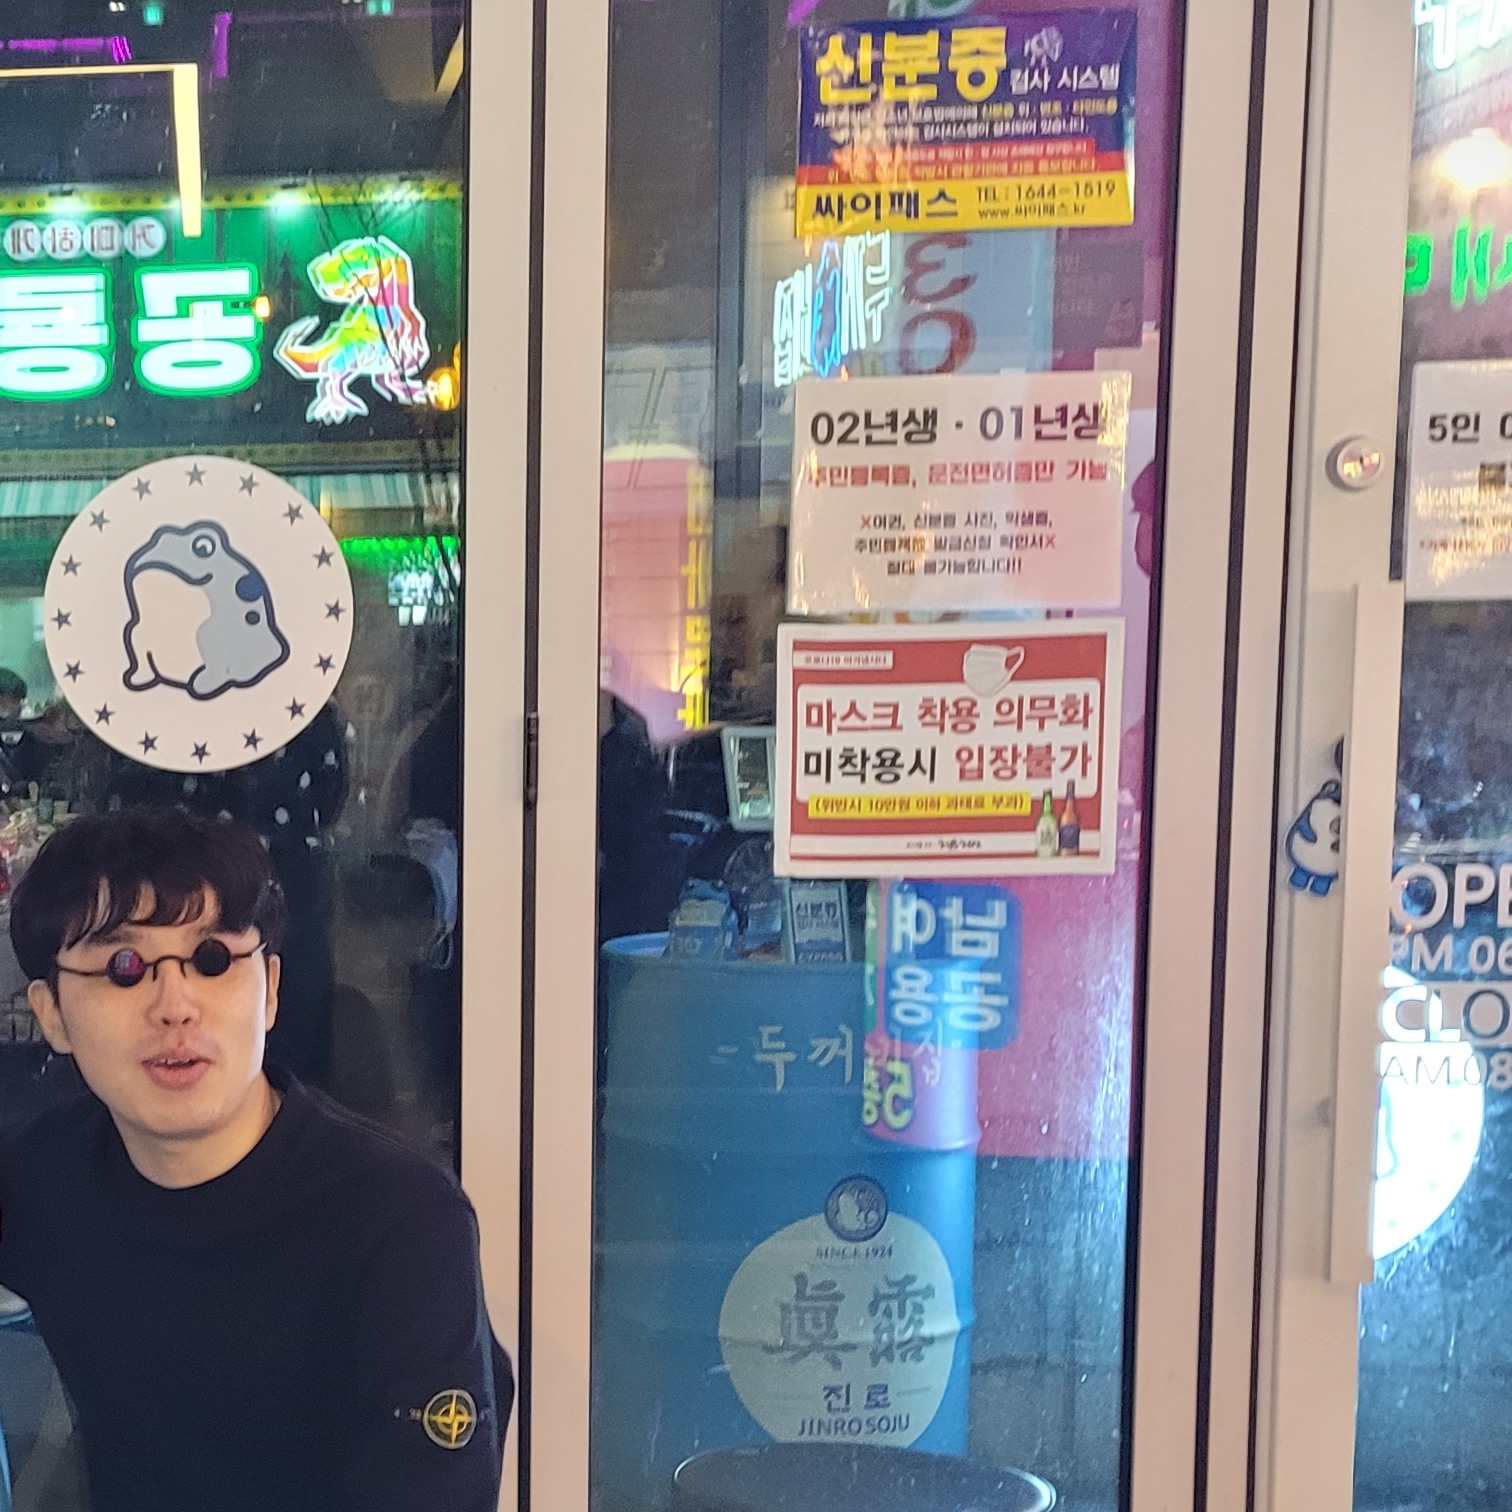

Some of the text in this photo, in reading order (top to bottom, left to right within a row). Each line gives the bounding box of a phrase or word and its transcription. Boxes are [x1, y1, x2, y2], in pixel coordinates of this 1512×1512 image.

[815, 26, 1007, 105] 신분증
[1057, 63, 1120, 91] 시스템
[813, 187, 959, 222] 싸이패스
[810, 402, 1108, 447] 02년생 01년생
[1429, 412, 1481, 444] 5인
[805, 692, 1093, 735] 마스크 착용 의무화
[803, 743, 1093, 785] 미착용시 입장불가
[1391, 933, 1454, 973] PM
[822, 1381, 892, 1413] 진로
[798, 1413, 911, 1437] JINRO SOJU
